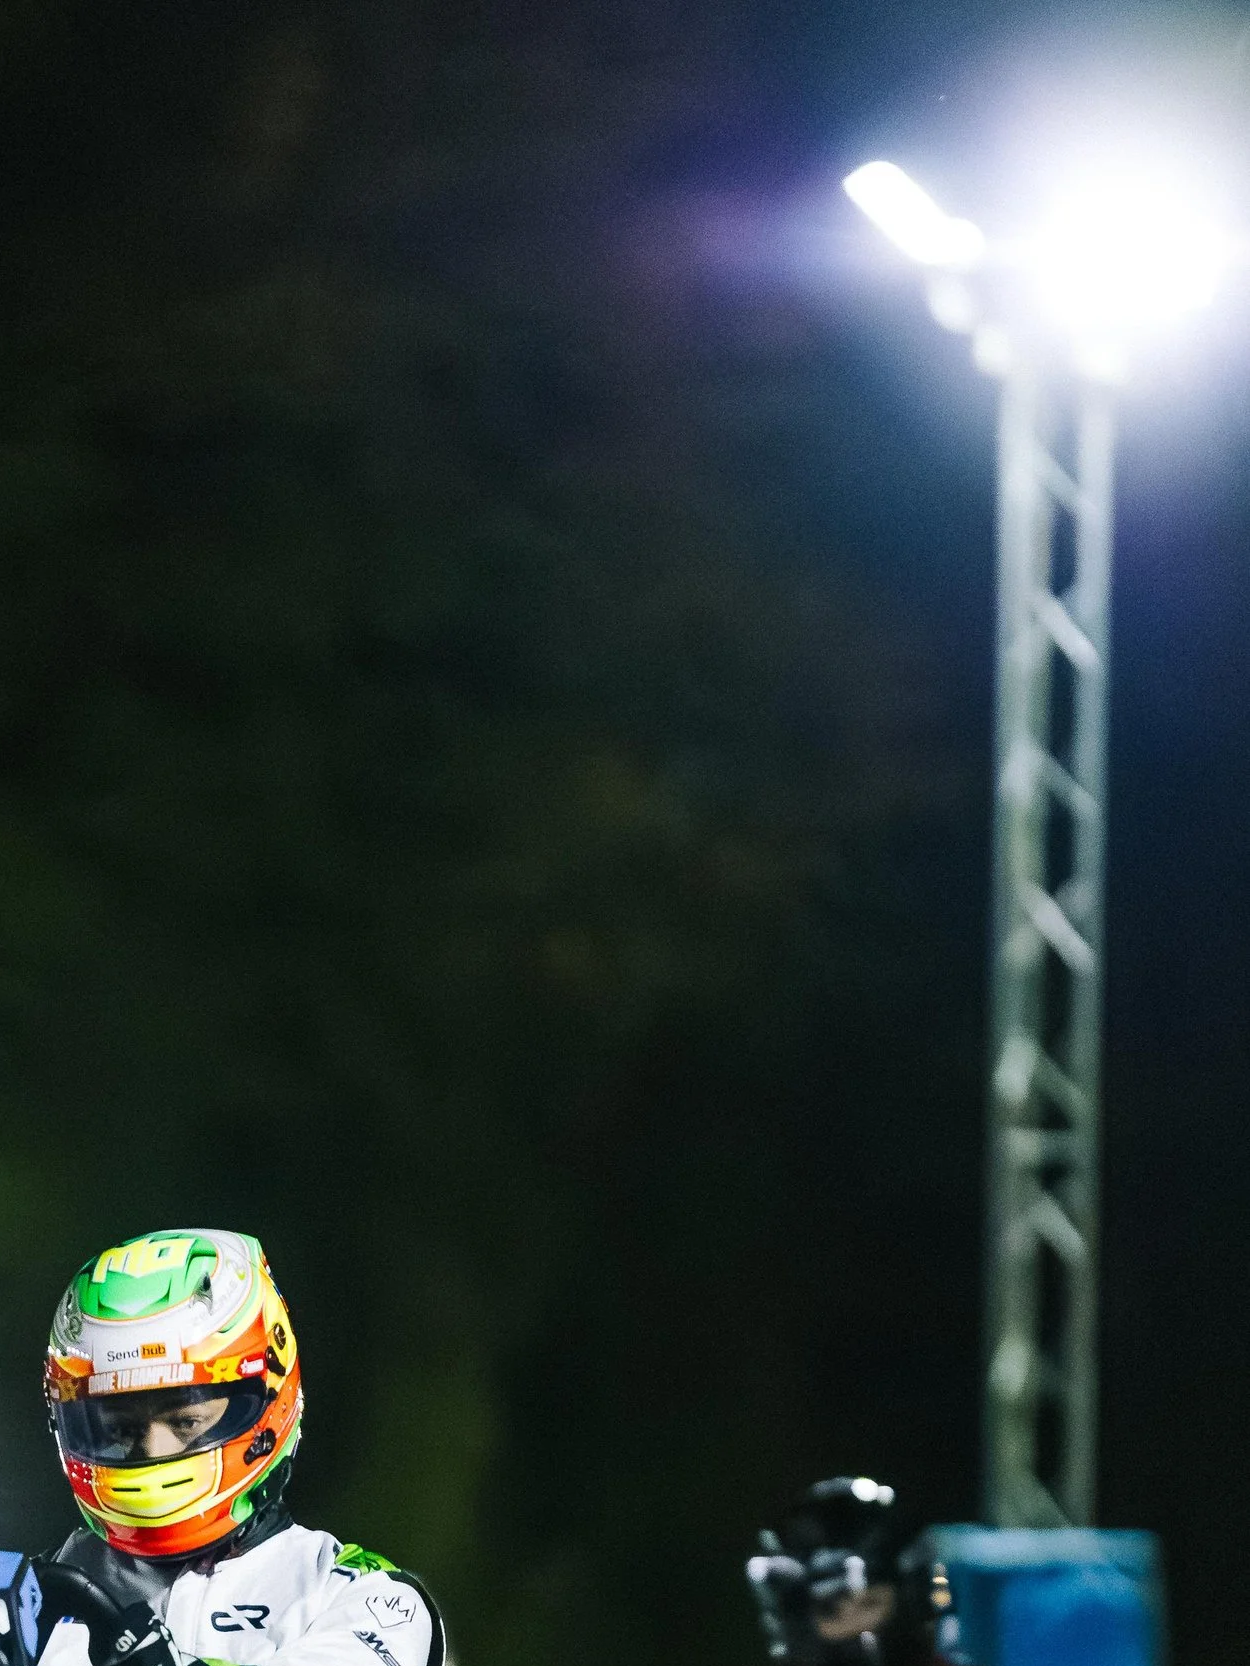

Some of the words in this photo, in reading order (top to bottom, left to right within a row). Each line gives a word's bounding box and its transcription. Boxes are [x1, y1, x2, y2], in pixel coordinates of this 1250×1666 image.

[107, 1347, 139, 1362] Send
[141, 1343, 166, 1356] hub
[210, 1604, 271, 1632] CR
